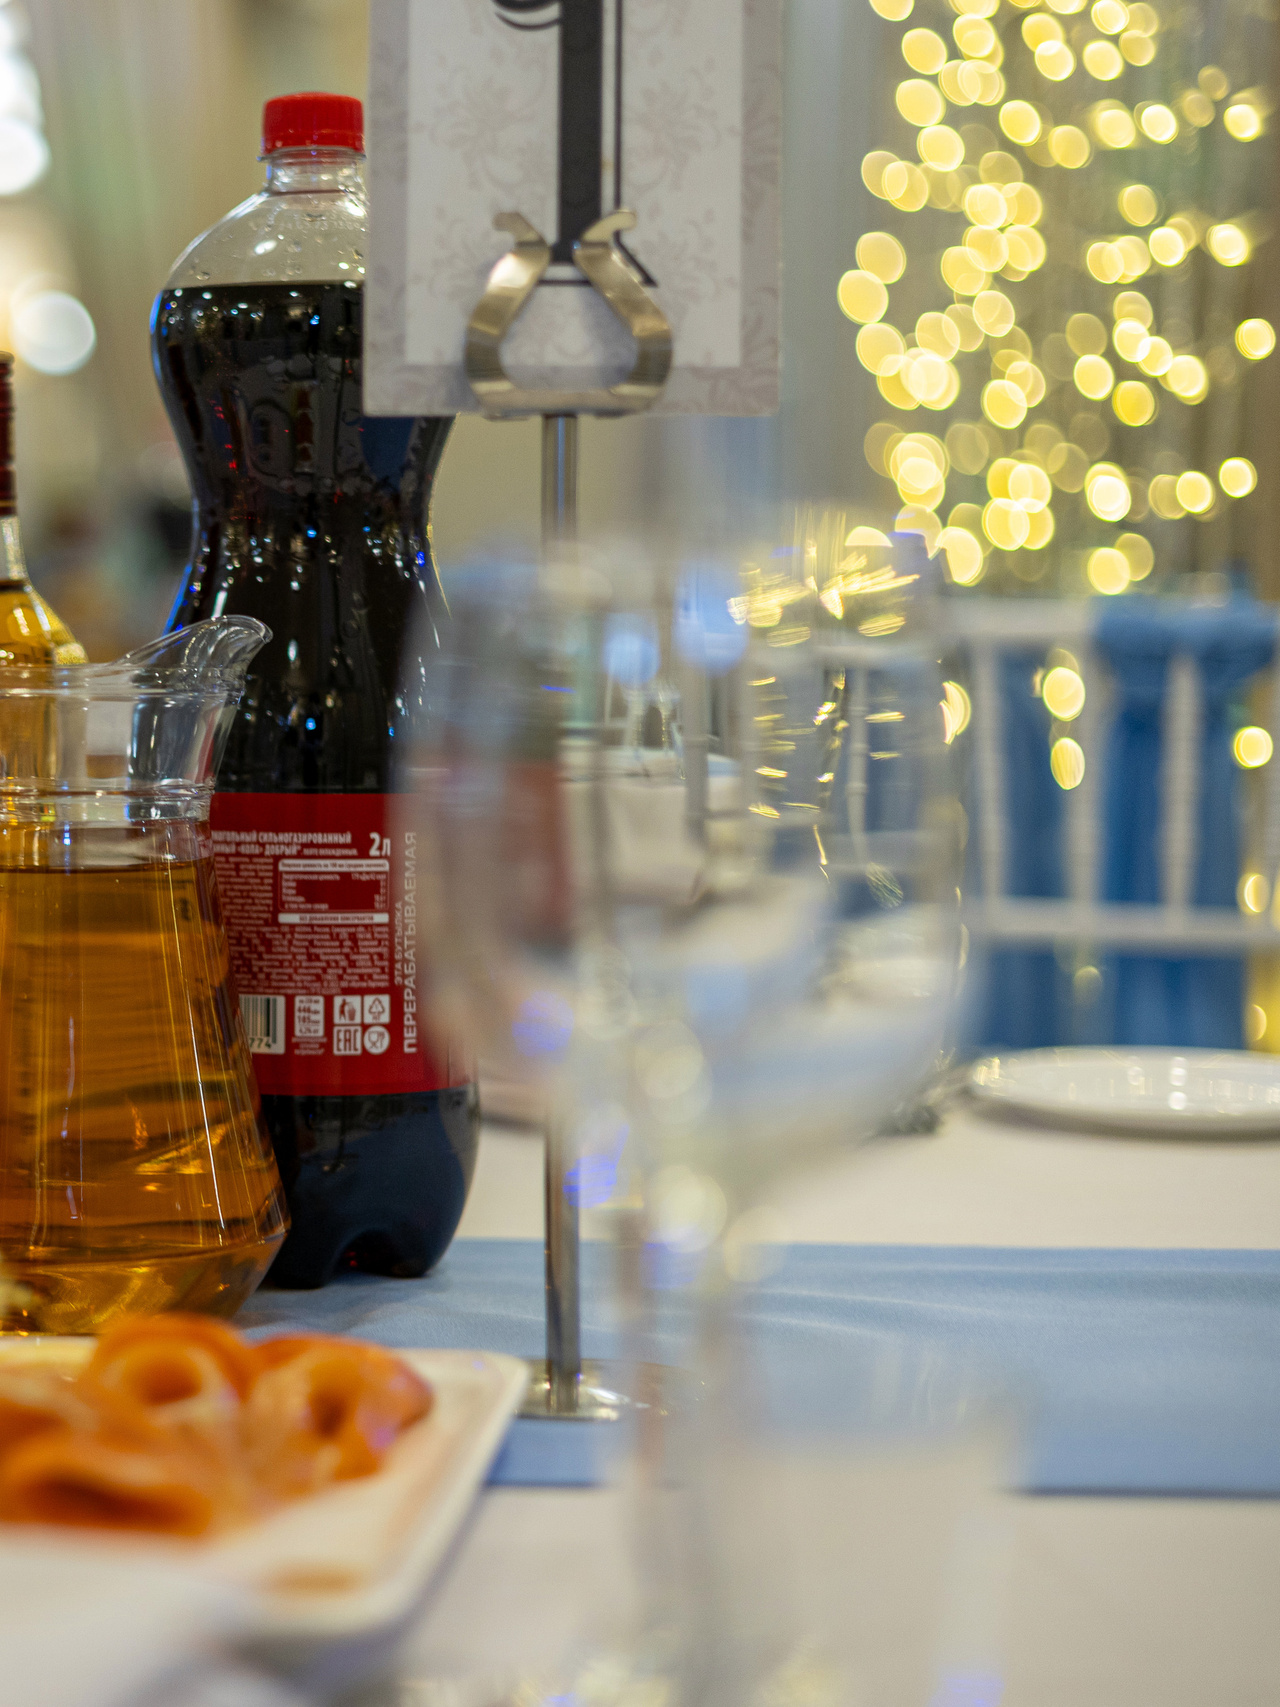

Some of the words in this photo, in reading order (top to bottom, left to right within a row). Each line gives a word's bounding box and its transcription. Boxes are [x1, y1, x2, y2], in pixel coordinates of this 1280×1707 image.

[210, 830, 257, 843] КОГОЛЬНЫЙ
[258, 831, 352, 845] СИЛЬНОГАЗИРОВАННЫЙ
[394, 901, 403, 960] БУТЫЛКА
[403, 831, 418, 1054] ПЕРЕРАБАТЫВАЕМАЯ
[394, 961, 403, 986] ЭТА
[249, 1037, 273, 1049] 774
[336, 1028, 360, 1053] EAC
